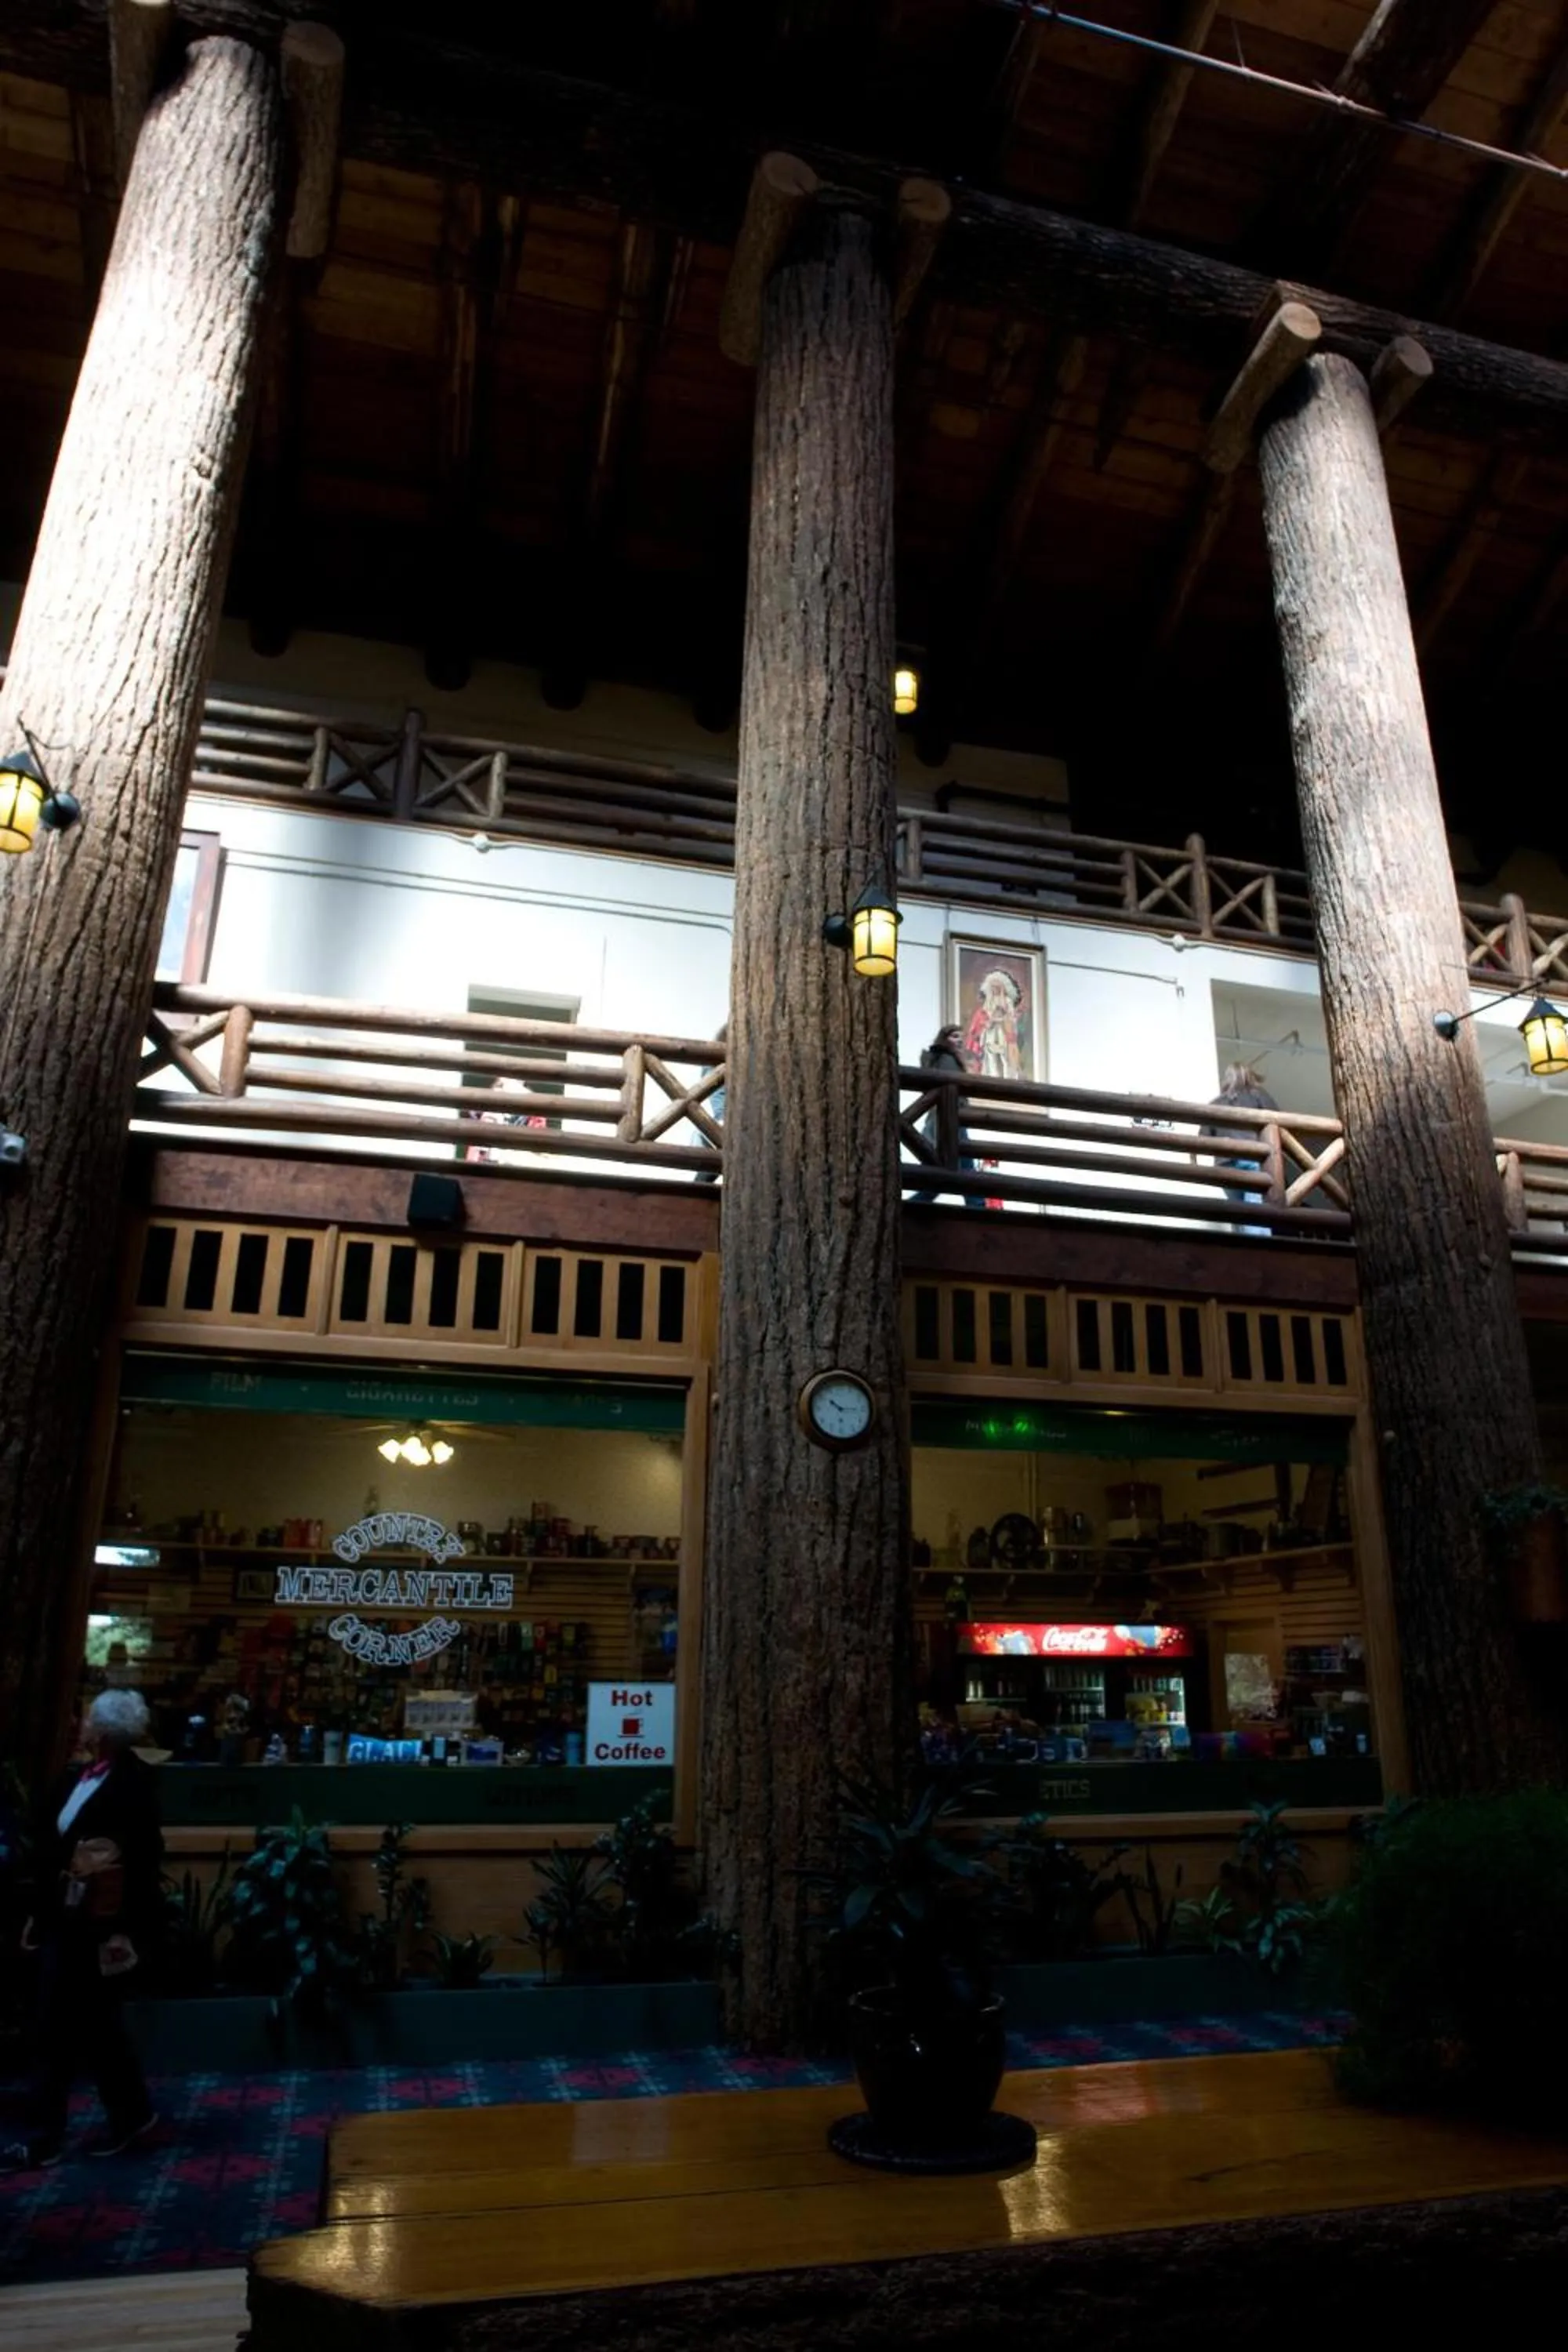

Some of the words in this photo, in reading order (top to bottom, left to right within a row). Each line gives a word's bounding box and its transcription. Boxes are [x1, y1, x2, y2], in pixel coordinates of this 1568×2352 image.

[332, 1512, 467, 1565] COUNTRY
[274, 1566, 514, 1610] MERCANTILE
[328, 1612, 461, 1667] CORNER
[612, 1690, 652, 1706] Hot
[595, 1743, 666, 1760] Coffee
